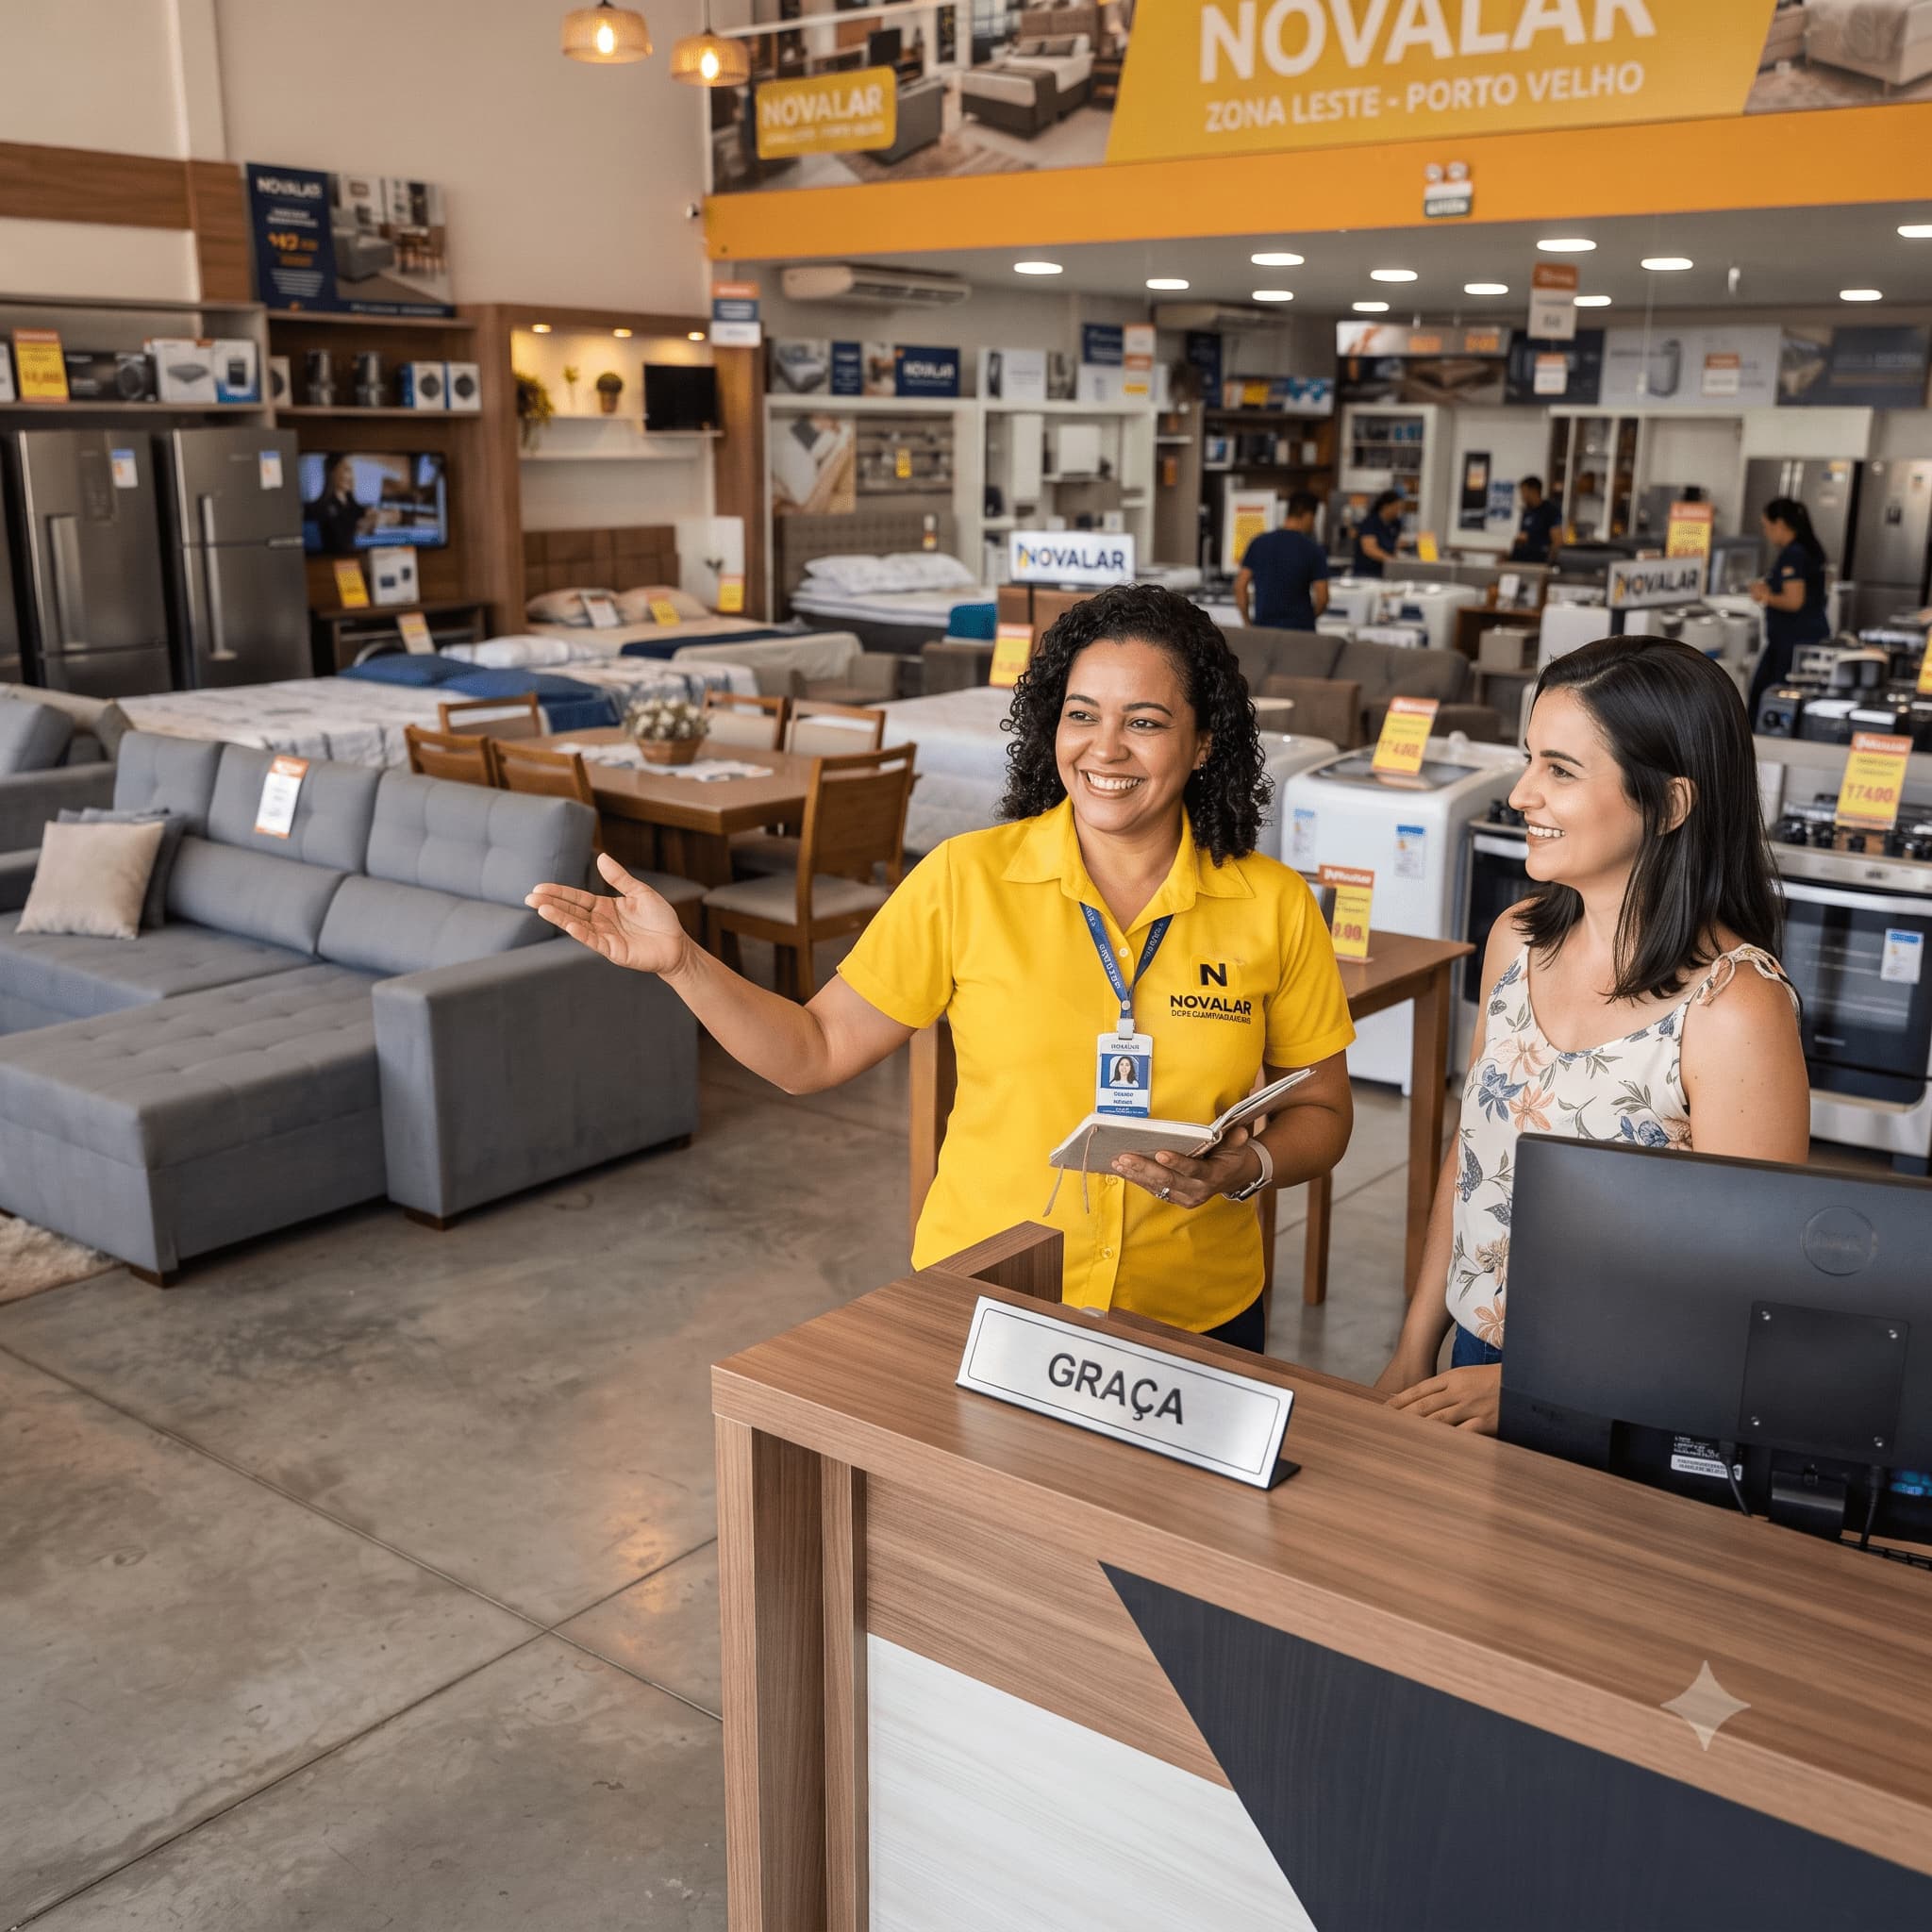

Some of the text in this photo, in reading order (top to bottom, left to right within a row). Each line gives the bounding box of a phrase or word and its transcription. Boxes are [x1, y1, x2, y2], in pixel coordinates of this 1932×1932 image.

[762, 83, 884, 129] NOVALAR
[1205, 95, 1286, 132] ZONA
[1292, 86, 1381, 125] LESTE
[1406, 73, 1519, 114] PORTO
[1524, 59, 1645, 103] VELHO
[1200, 963, 1227, 987] N
[1170, 994, 1252, 1016] NOVALAR
[1048, 1352, 1184, 1424] GRAÇA
